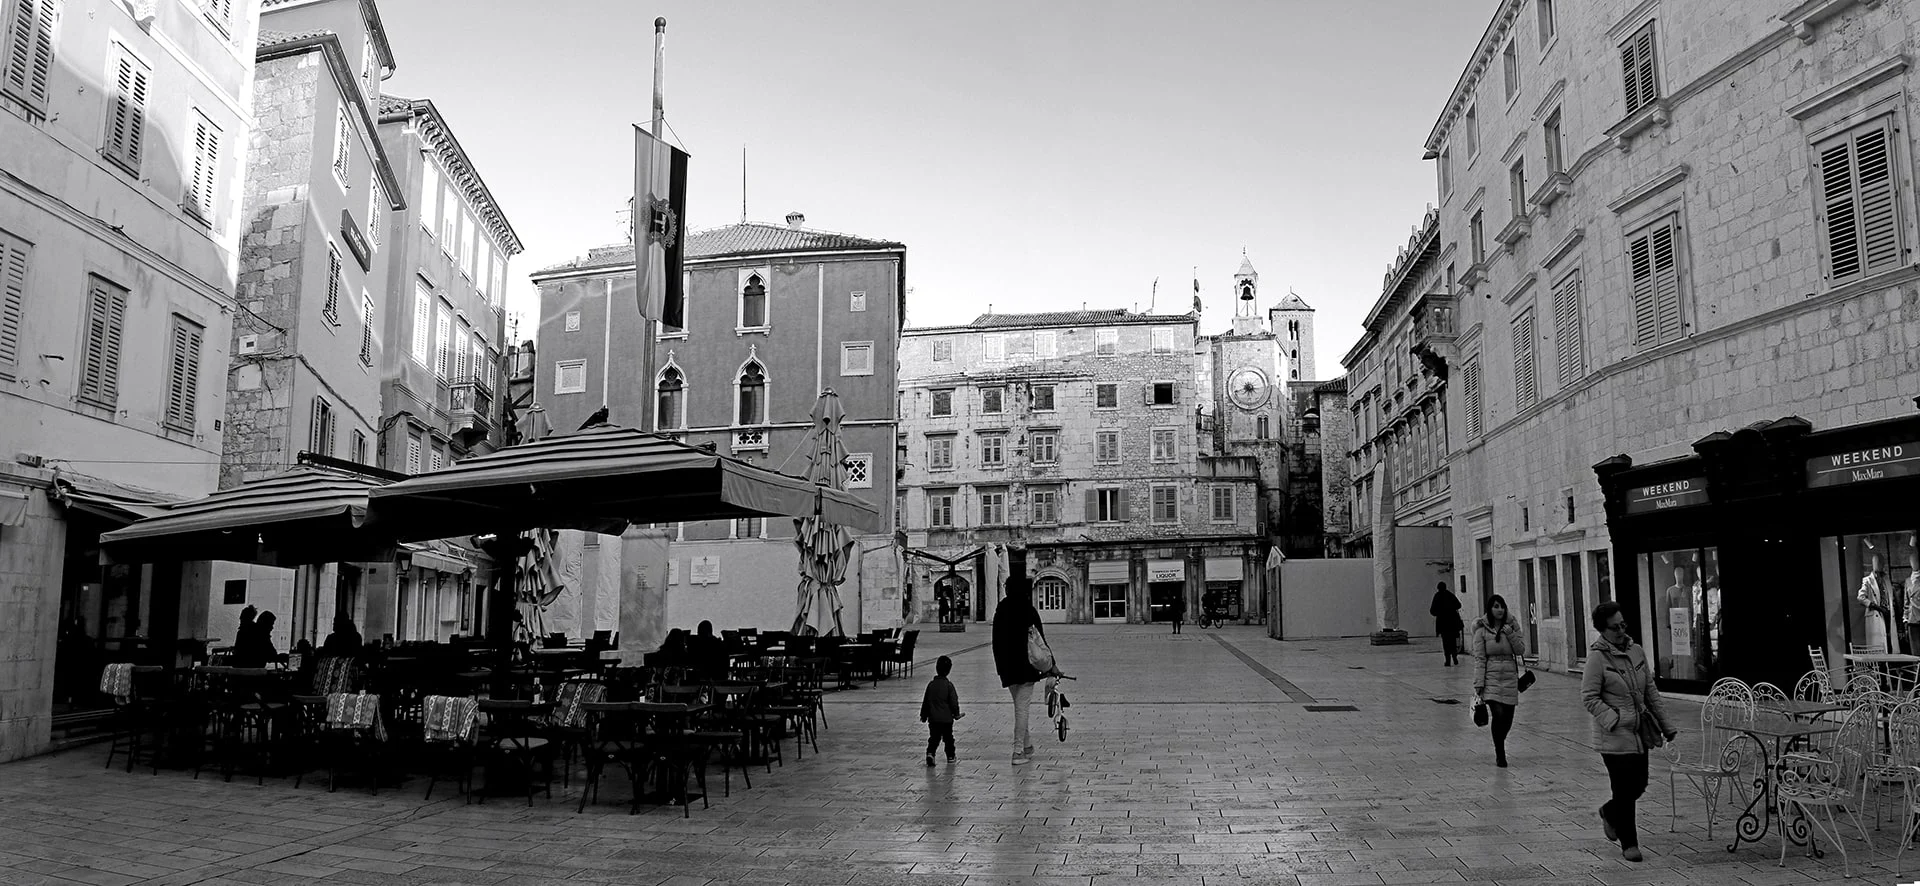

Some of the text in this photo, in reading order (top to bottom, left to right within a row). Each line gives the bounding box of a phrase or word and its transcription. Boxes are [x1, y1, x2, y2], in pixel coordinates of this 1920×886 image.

[1831, 445, 1903, 466] WEEKEND
[1851, 468, 1884, 482] MaxMara
[1642, 480, 1689, 497] WEEKEND
[1655, 498, 1677, 510] MaxMara
